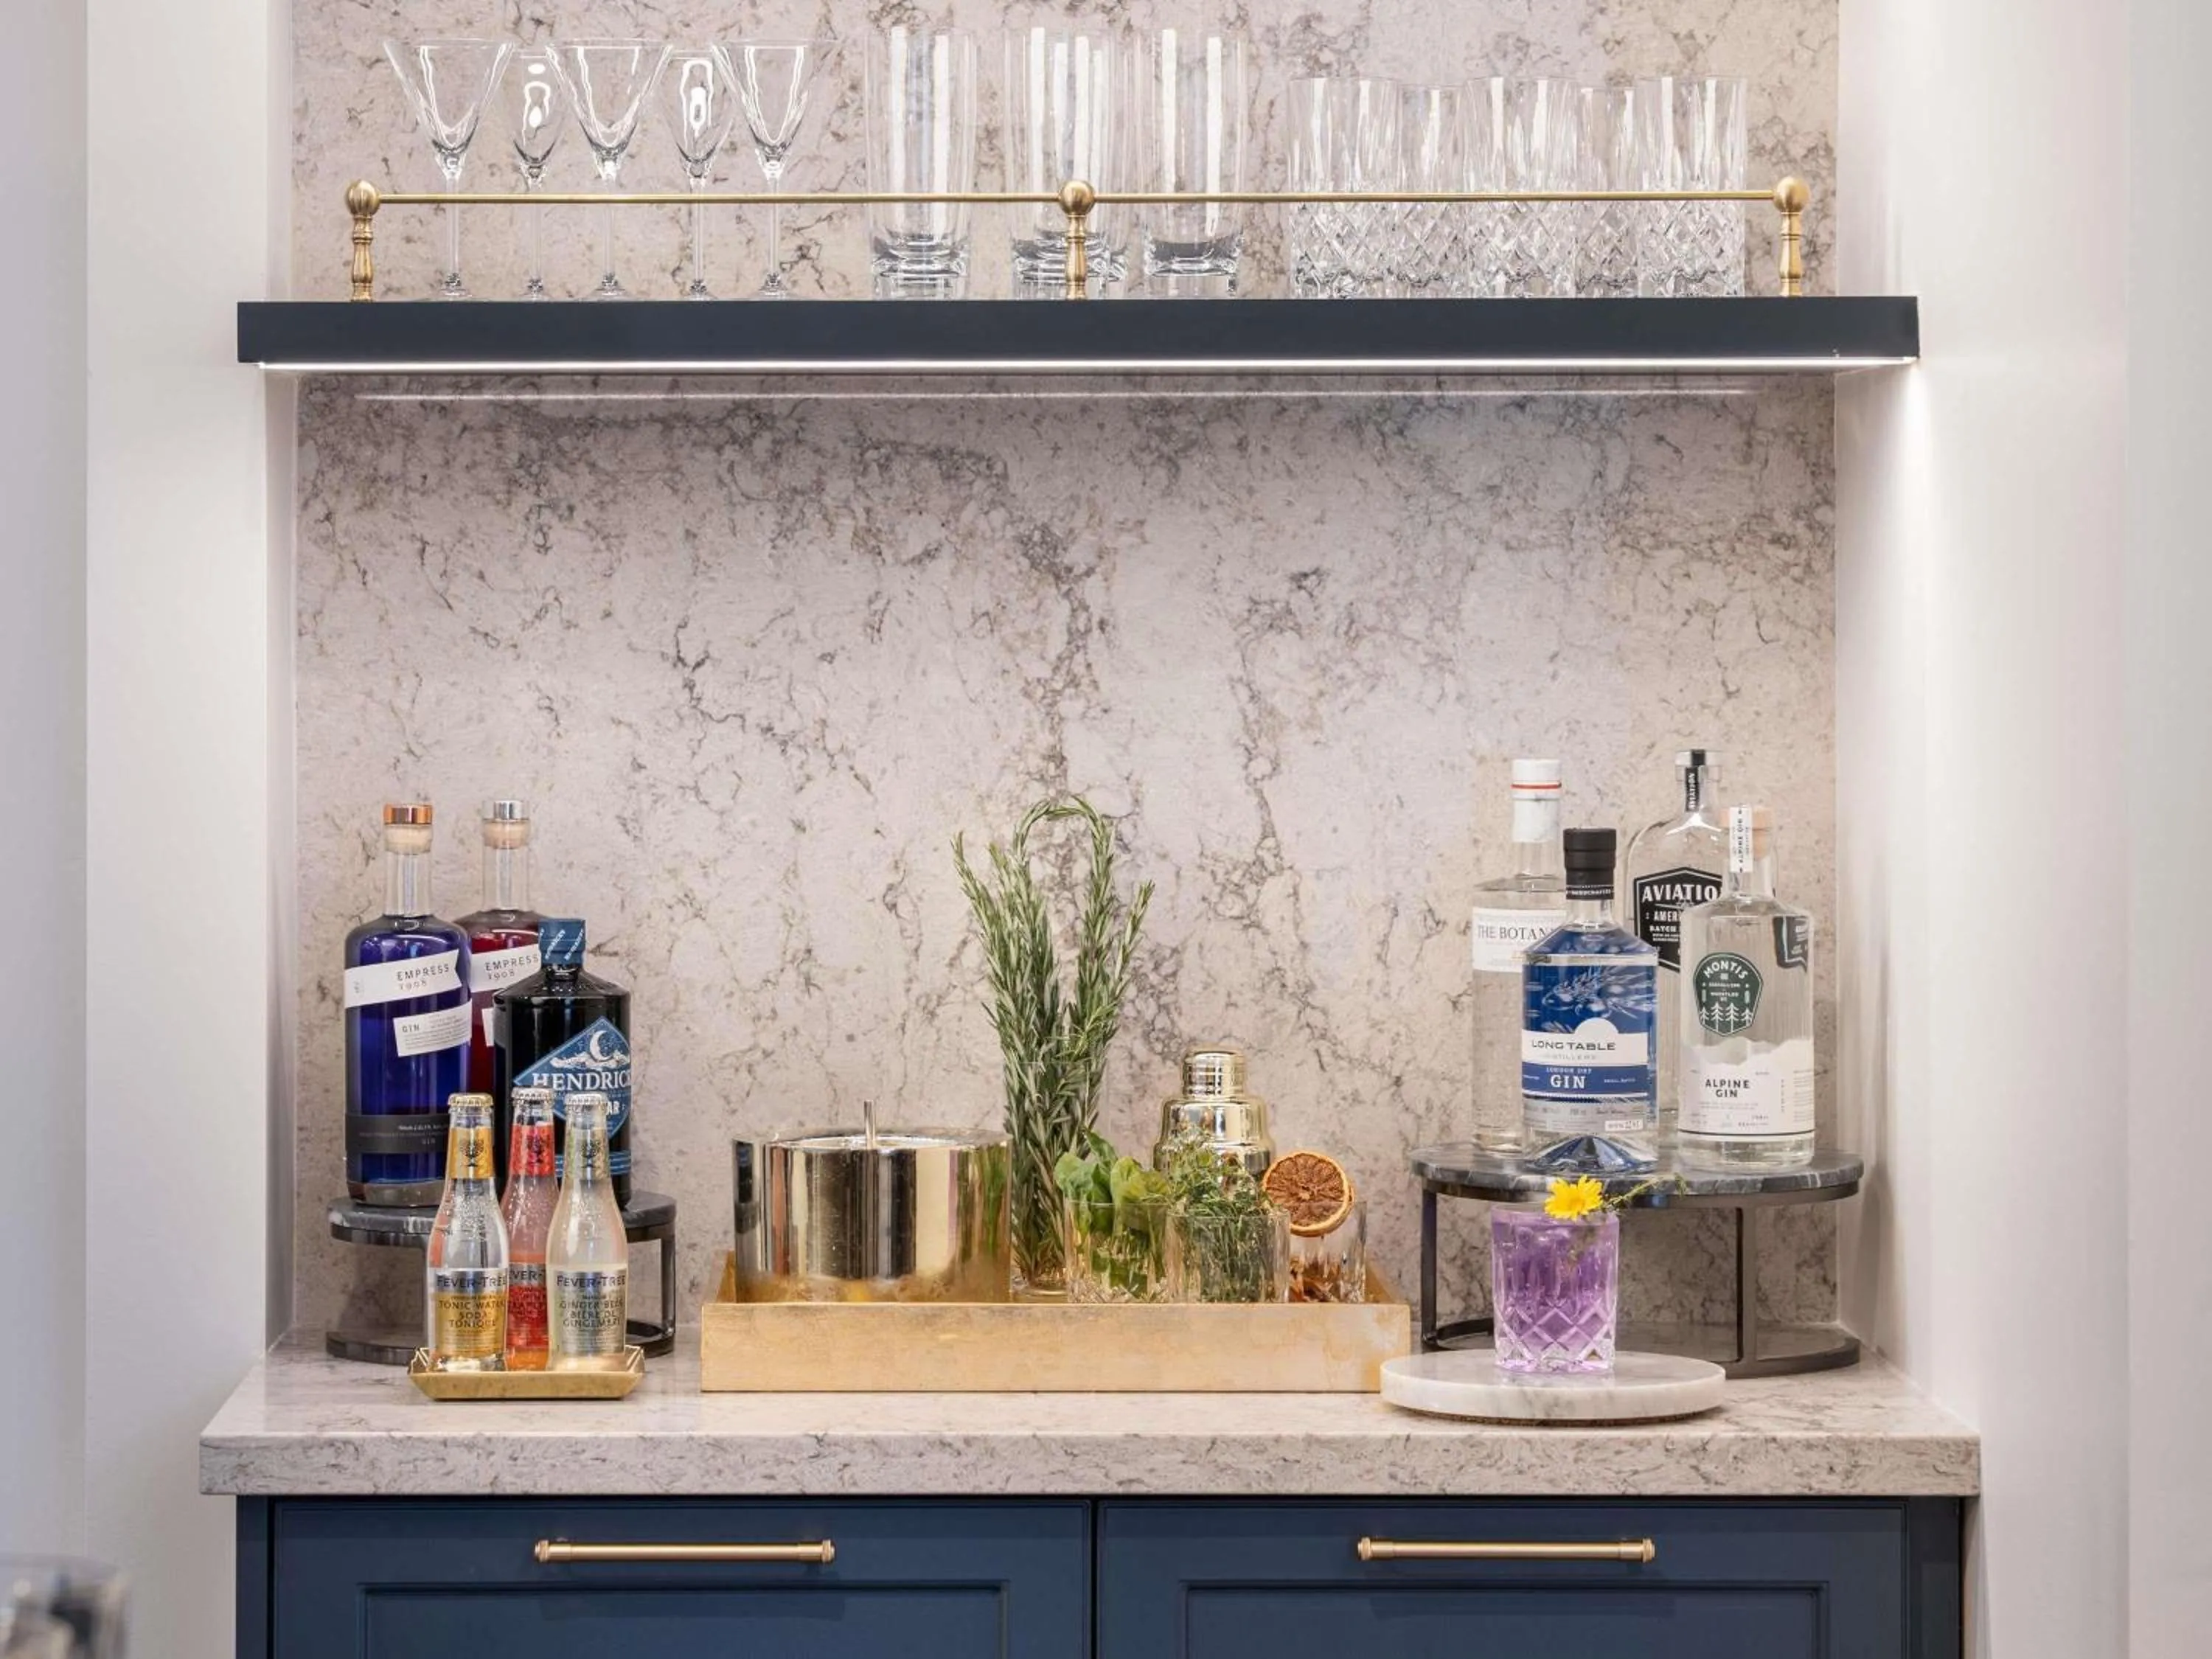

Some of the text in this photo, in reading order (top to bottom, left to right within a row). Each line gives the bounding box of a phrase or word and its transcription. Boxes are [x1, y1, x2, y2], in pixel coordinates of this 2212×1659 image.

[1641, 884, 1718, 902] AVIATIO
[1654, 911, 1678, 922] AMER
[1478, 925, 1547, 939] THE BOTAN
[485, 954, 539, 971] EMPRESS
[397, 964, 449, 981] EMPRESS
[1703, 960, 1748, 978] MONTIS
[488, 971, 515, 980] 1908
[402, 1024, 420, 1033] GIN
[1531, 1039, 1616, 1051] LONG TABLE
[532, 1070, 630, 1091] HENDRIC
[1551, 1074, 1586, 1089] GIN
[1705, 1079, 1751, 1089] ALPINE
[1715, 1089, 1739, 1098] GIN
[557, 1275, 626, 1287] FEVER-TREE
[438, 1300, 471, 1310] TONIC
